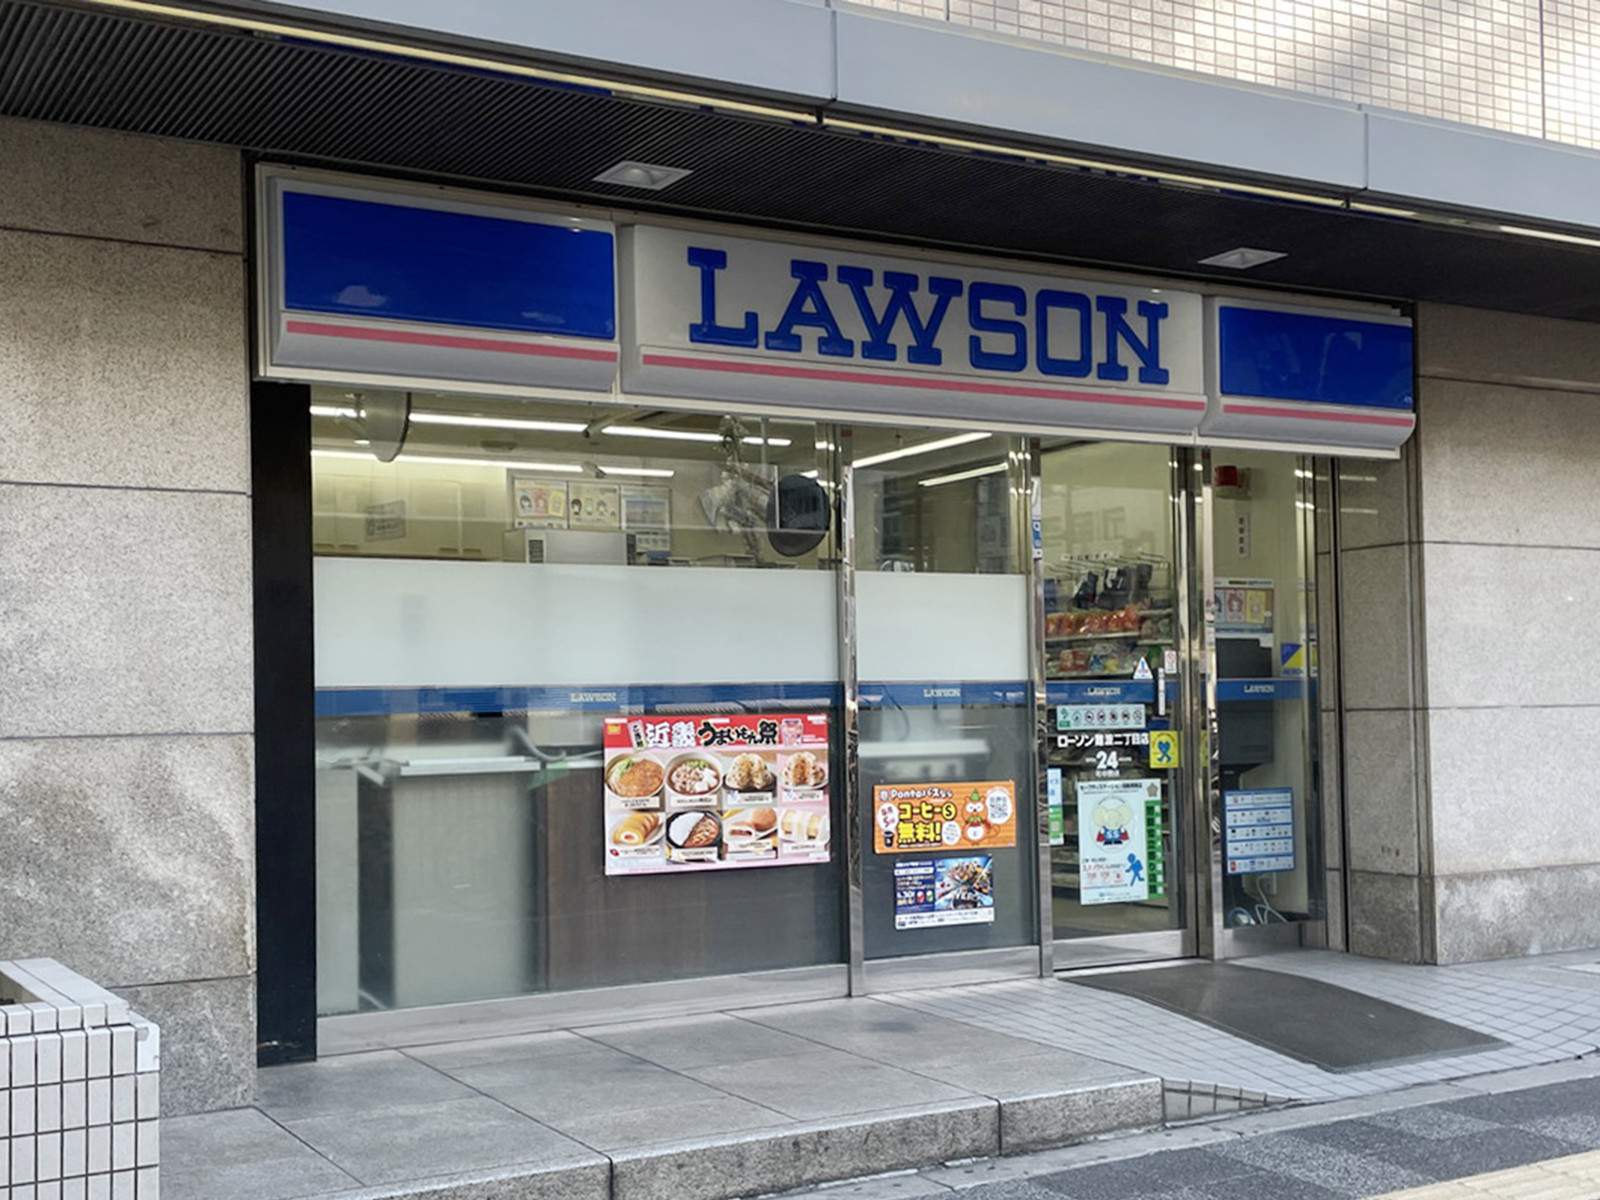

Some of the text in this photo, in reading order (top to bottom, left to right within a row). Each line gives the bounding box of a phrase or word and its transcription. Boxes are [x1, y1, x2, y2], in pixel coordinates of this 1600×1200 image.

[687, 246, 1169, 385] LAWSON
[570, 692, 616, 702] LAWSON
[1096, 750, 1119, 769] 24
